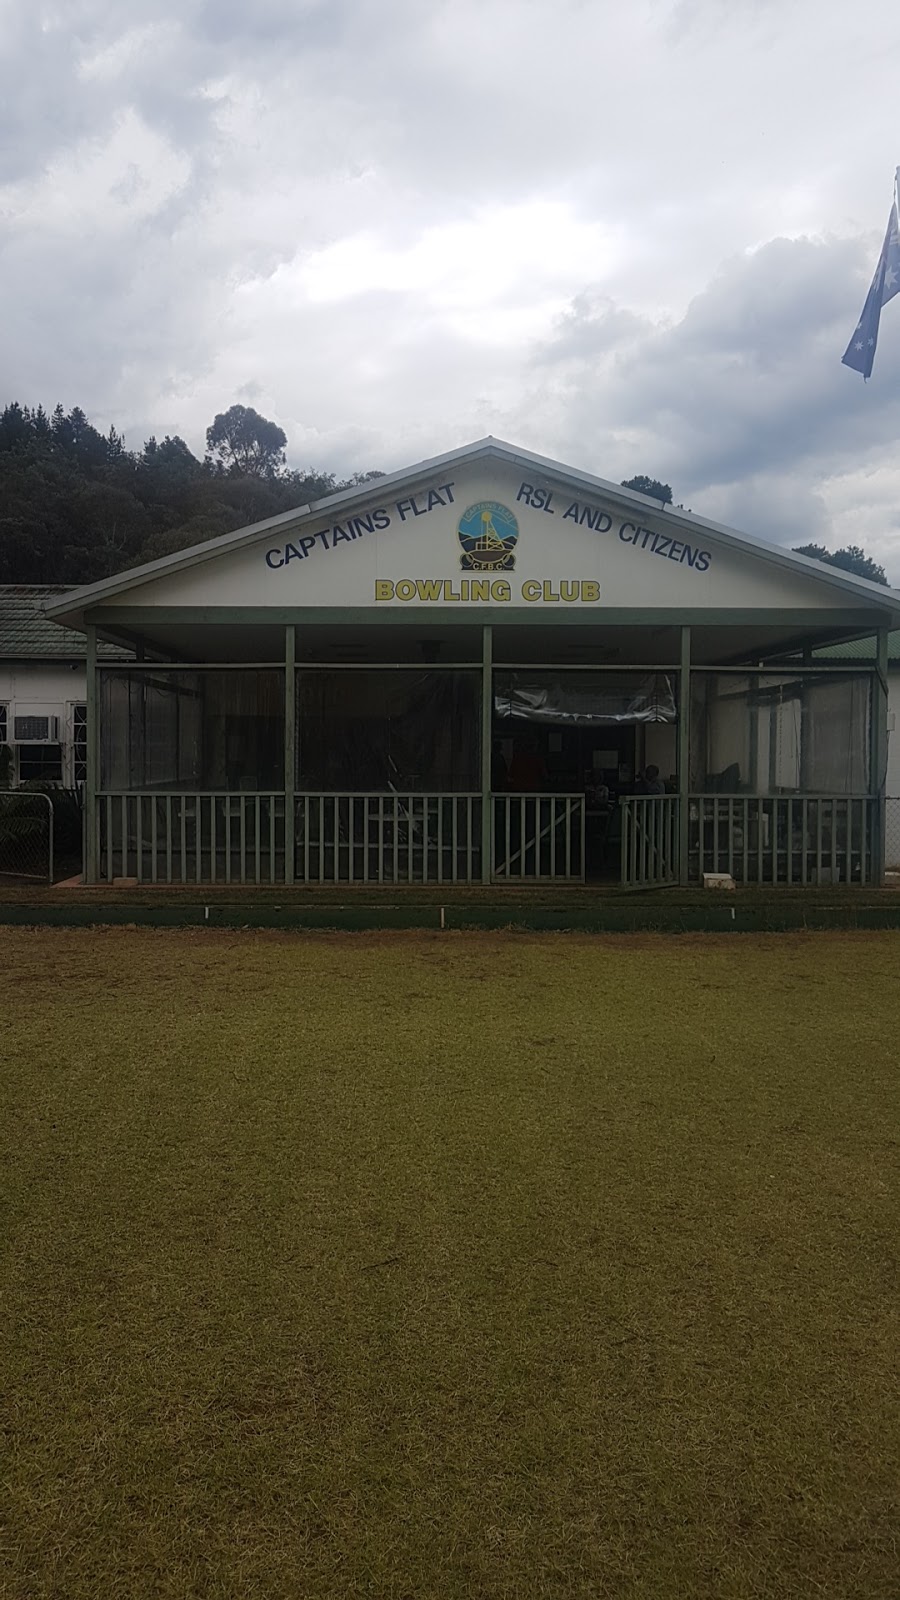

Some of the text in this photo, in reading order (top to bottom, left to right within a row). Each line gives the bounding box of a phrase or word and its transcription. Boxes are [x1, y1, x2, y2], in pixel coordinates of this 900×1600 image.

[465, 503, 497, 519] CAPTAINS
[265, 482, 712, 572] CAPTAINS FLAT RSL AND CITIZENS
[375, 579, 601, 602] BOWLING CLUB
